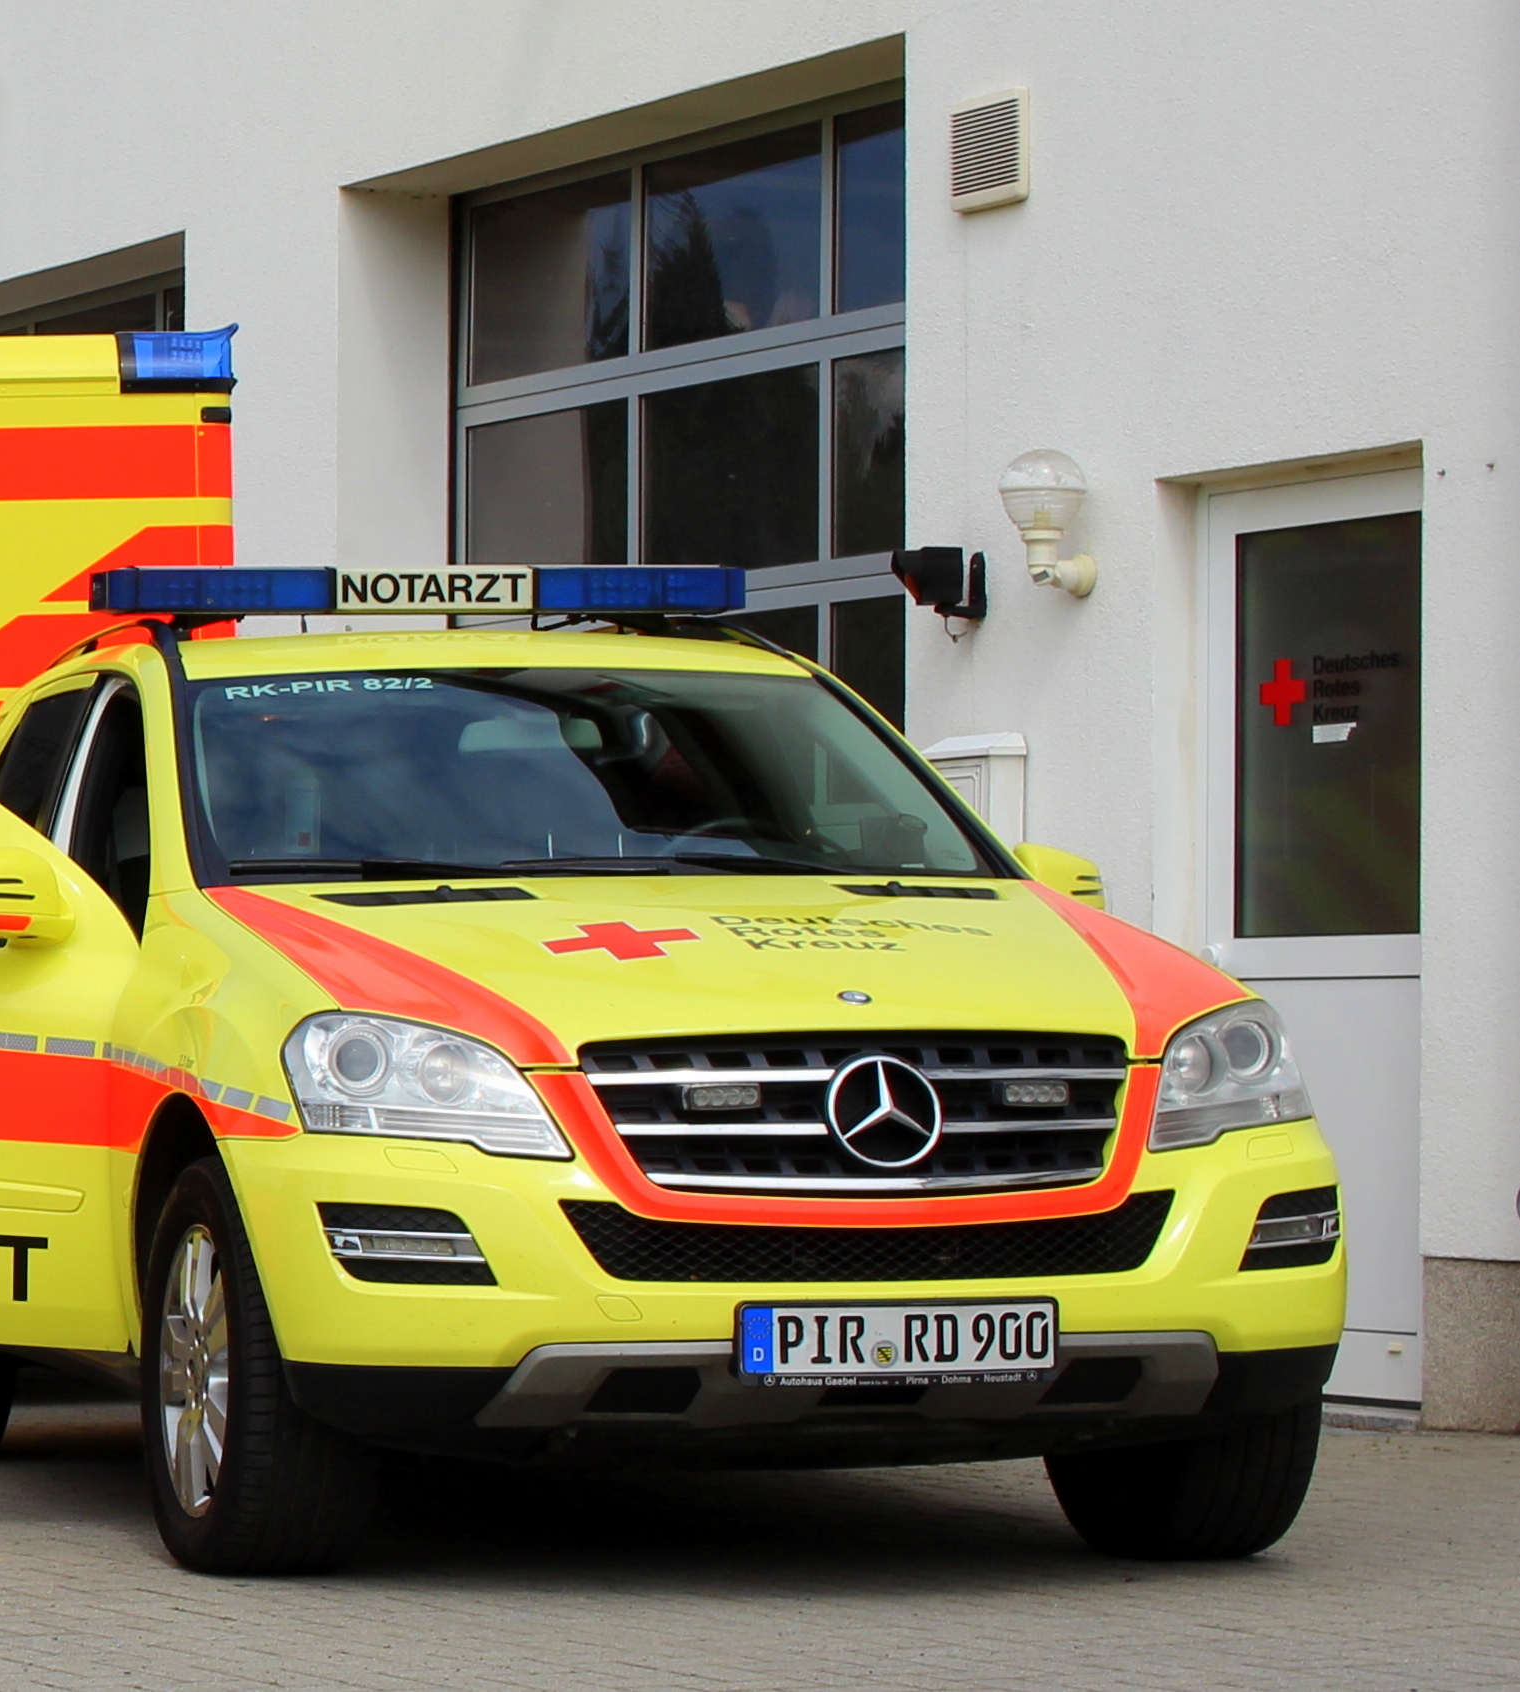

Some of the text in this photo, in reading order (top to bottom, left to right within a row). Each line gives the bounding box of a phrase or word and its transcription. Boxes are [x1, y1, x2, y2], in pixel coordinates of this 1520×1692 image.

[341, 572, 527, 604] NOTARZT
[1312, 650, 1401, 674] Deutsches
[224, 676, 434, 700] RK-PIR 82/2
[1312, 679, 1360, 698] Rotes
[1312, 703, 1360, 722] Kreuz
[709, 915, 993, 937] Deutsches
[726, 926, 887, 938] Rotes
[744, 938, 907, 951] Kreuz
[752, 1311, 1049, 1364] D PIR RD 900
[779, 1377, 822, 1386] Autohaus
[825, 1376, 857, 1386] Gaebel
[906, 1375, 929, 1385] Pirna
[941, 1374, 972, 1384] Dohma
[983, 1372, 1022, 1383] Neustadt
